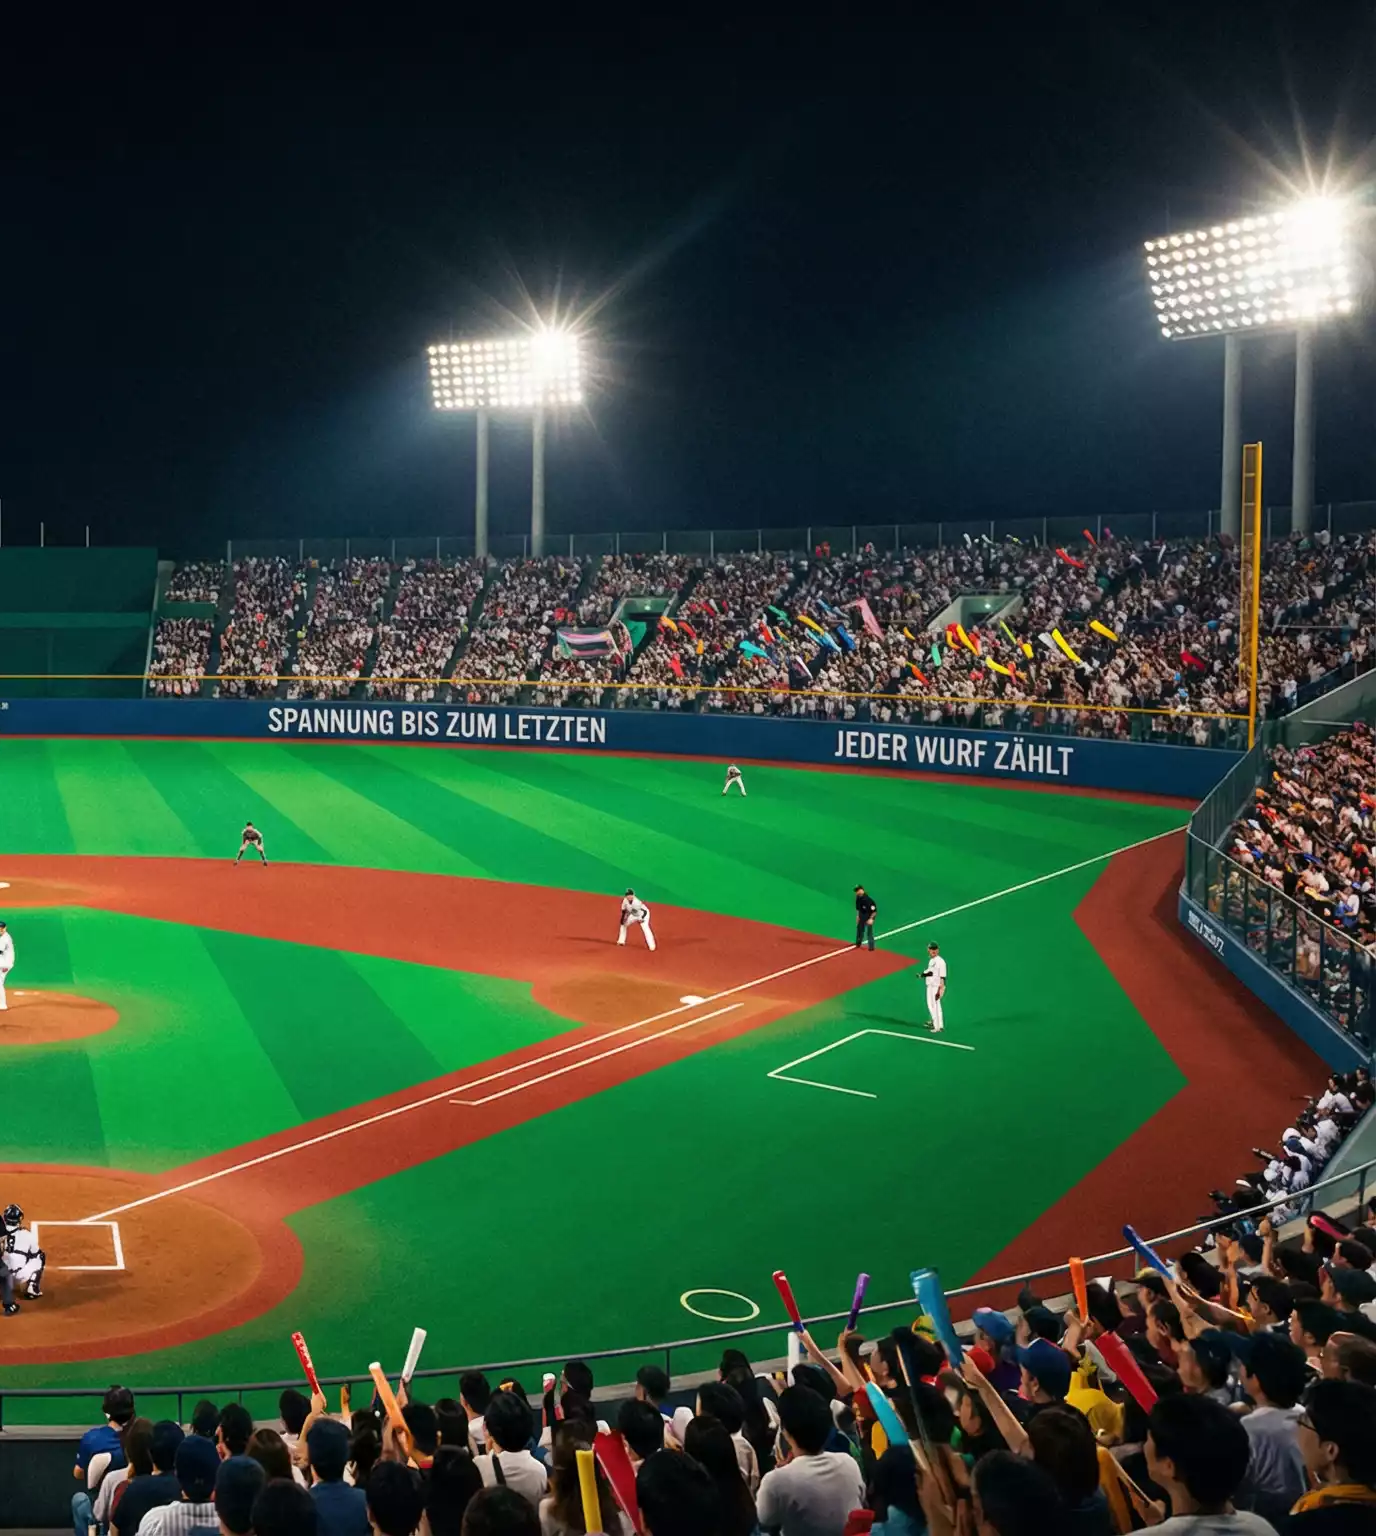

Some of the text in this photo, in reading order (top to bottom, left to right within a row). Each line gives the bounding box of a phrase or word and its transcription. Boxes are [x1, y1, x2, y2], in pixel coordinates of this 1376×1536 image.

[268, 707, 606, 743] SPANNUNG BIS ZUM LETZTEN
[834, 730, 1074, 776] JEDER WURF ZÄHLT
